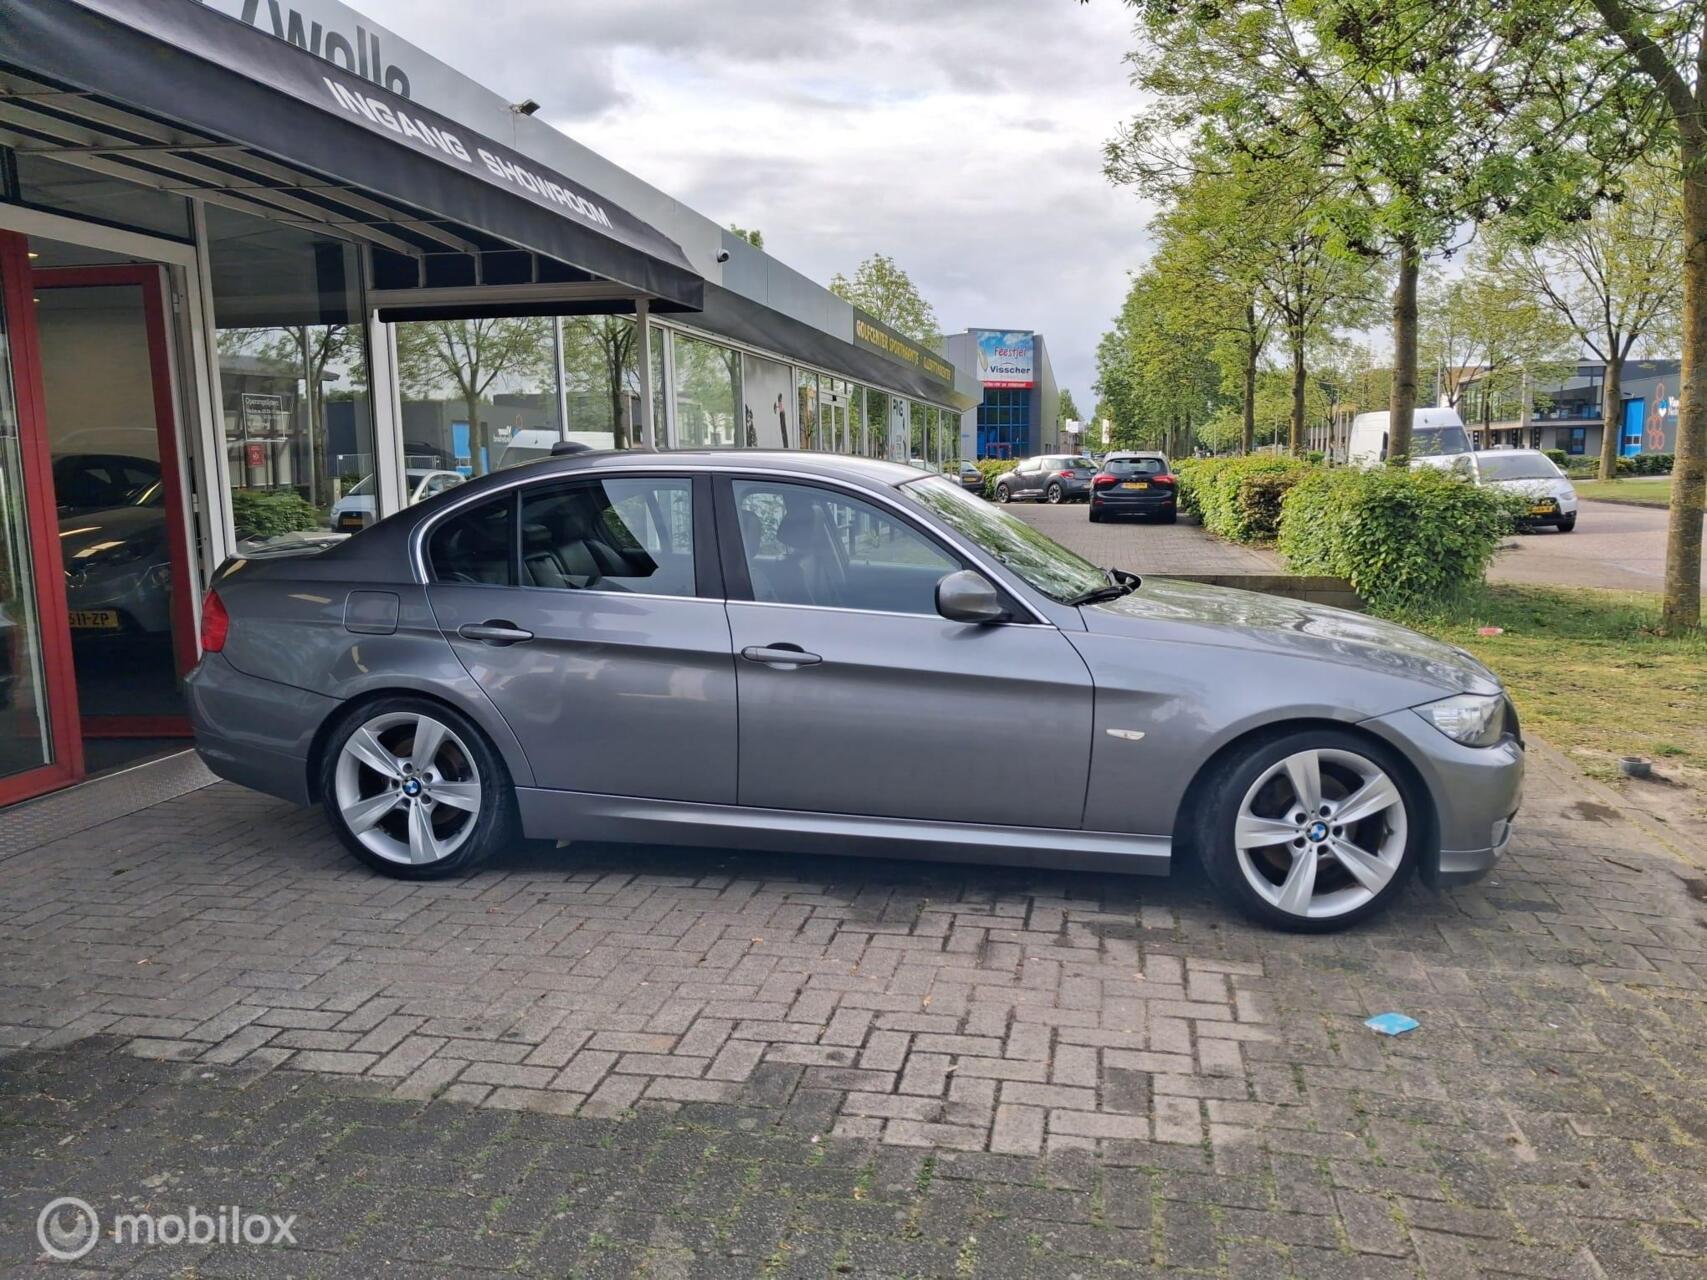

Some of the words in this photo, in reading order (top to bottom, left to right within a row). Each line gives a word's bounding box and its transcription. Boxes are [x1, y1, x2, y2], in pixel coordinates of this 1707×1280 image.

[322, 76, 473, 164] INGANG
[477, 147, 614, 230] SHOWROOM
[990, 365, 1031, 374] Visscher
